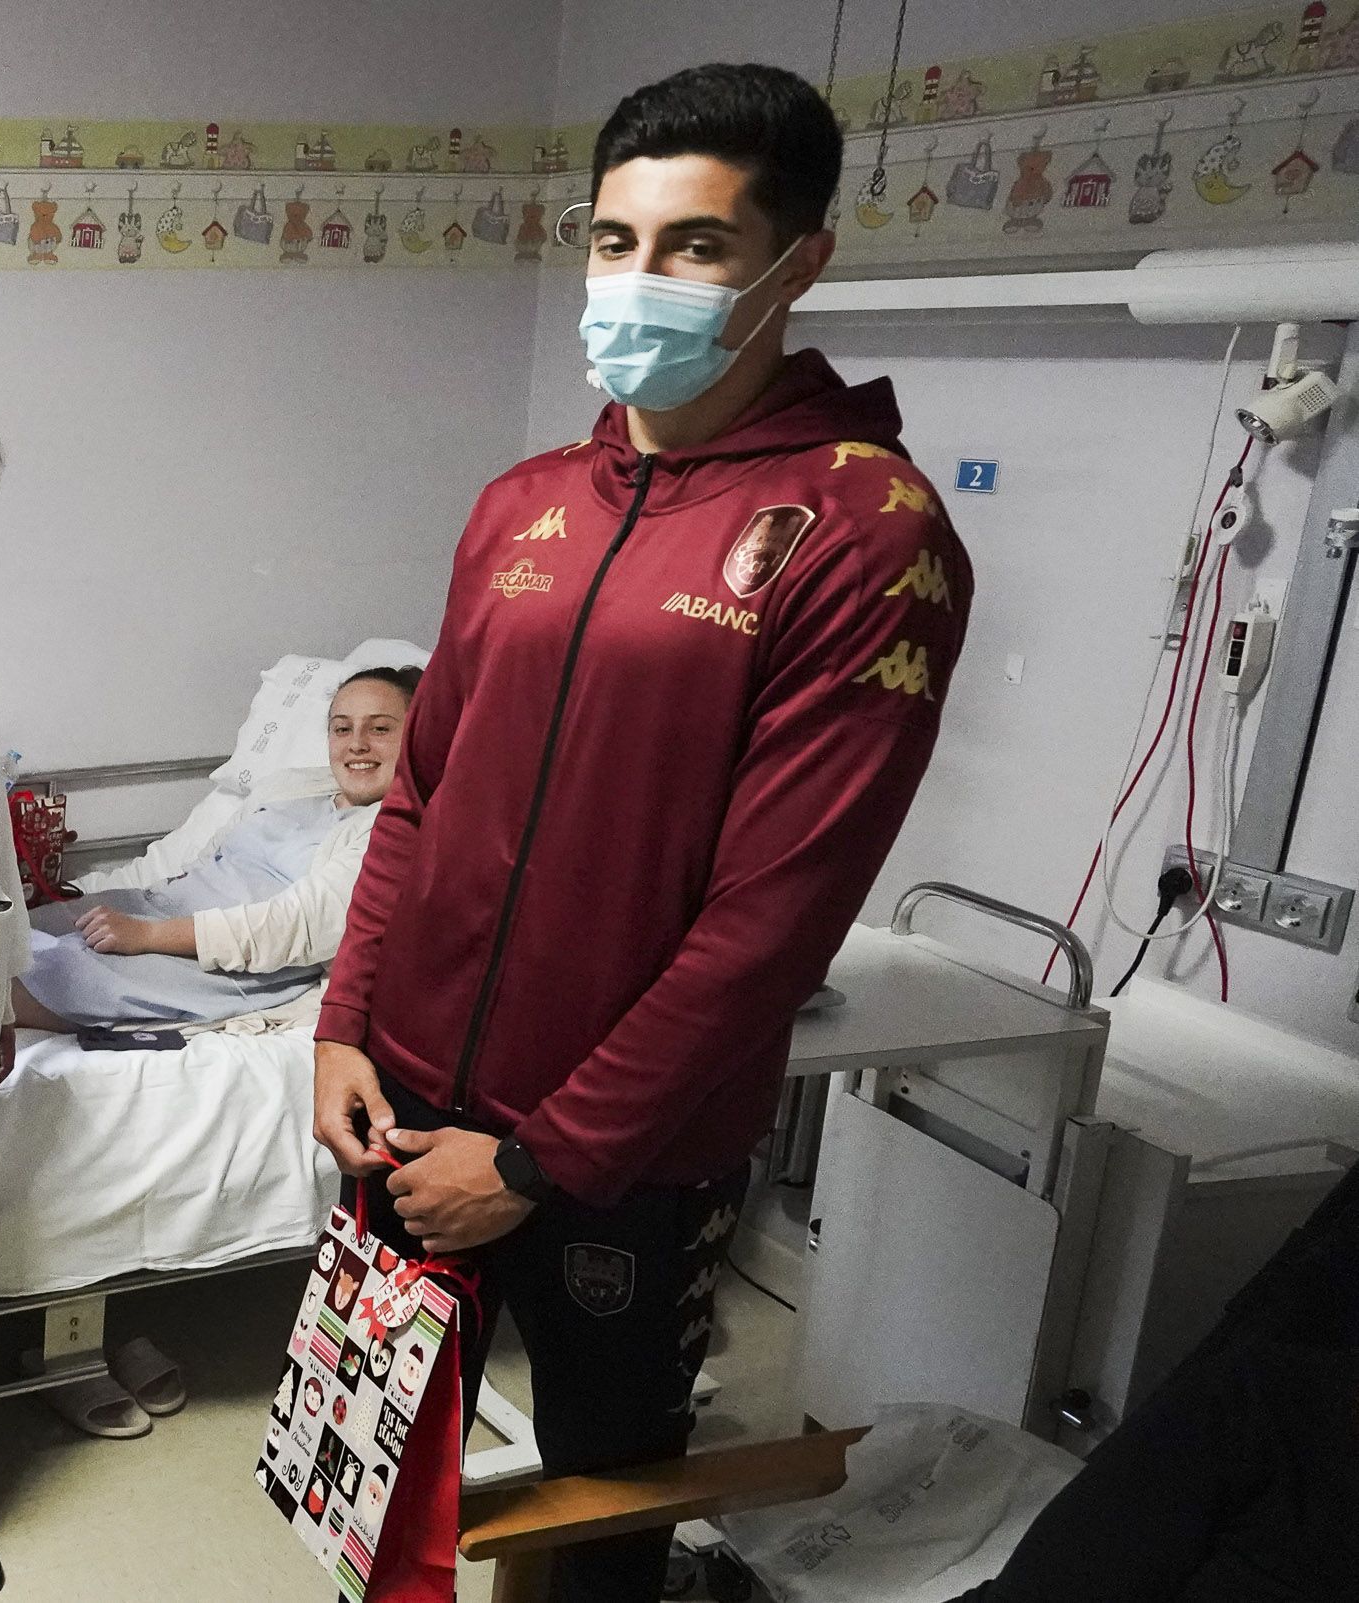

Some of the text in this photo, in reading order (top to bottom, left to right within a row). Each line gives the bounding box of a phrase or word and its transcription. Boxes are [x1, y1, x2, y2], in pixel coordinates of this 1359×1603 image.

[969, 464, 983, 487] 2
[298, 1421, 313, 1443] Merry
[395, 1414, 410, 1442] THE
[377, 1423, 404, 1460] SEASON
